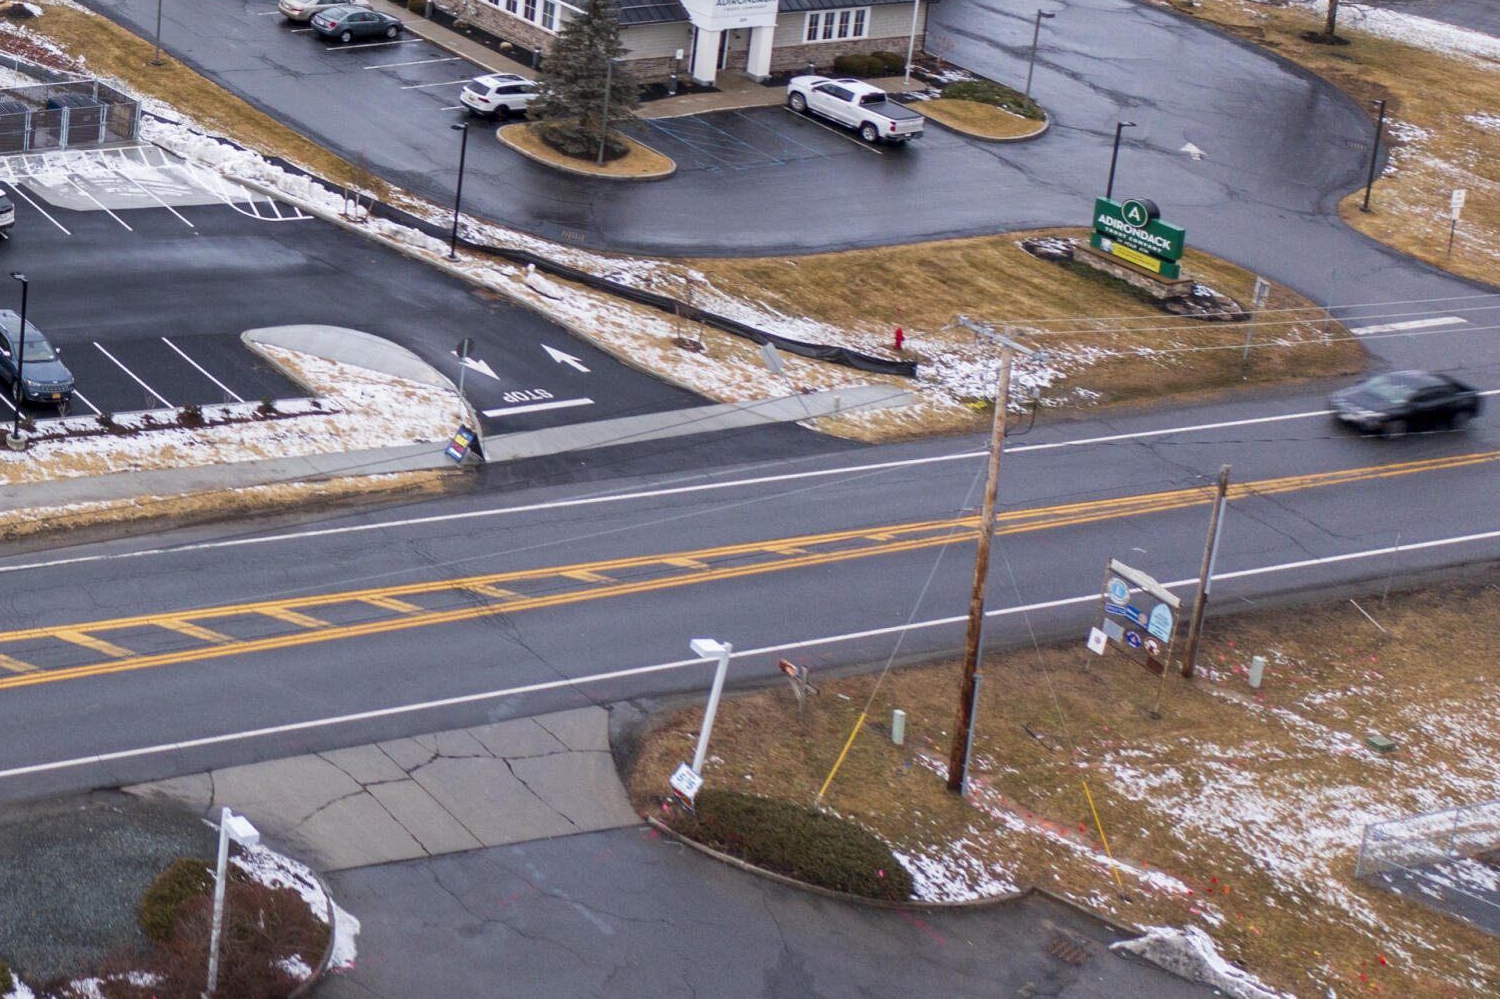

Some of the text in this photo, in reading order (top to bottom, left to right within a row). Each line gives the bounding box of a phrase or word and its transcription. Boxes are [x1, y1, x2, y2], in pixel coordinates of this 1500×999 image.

[1128, 206, 1141, 222] A
[1098, 214, 1172, 250] ADIRONDACK
[503, 388, 554, 402] STOP
